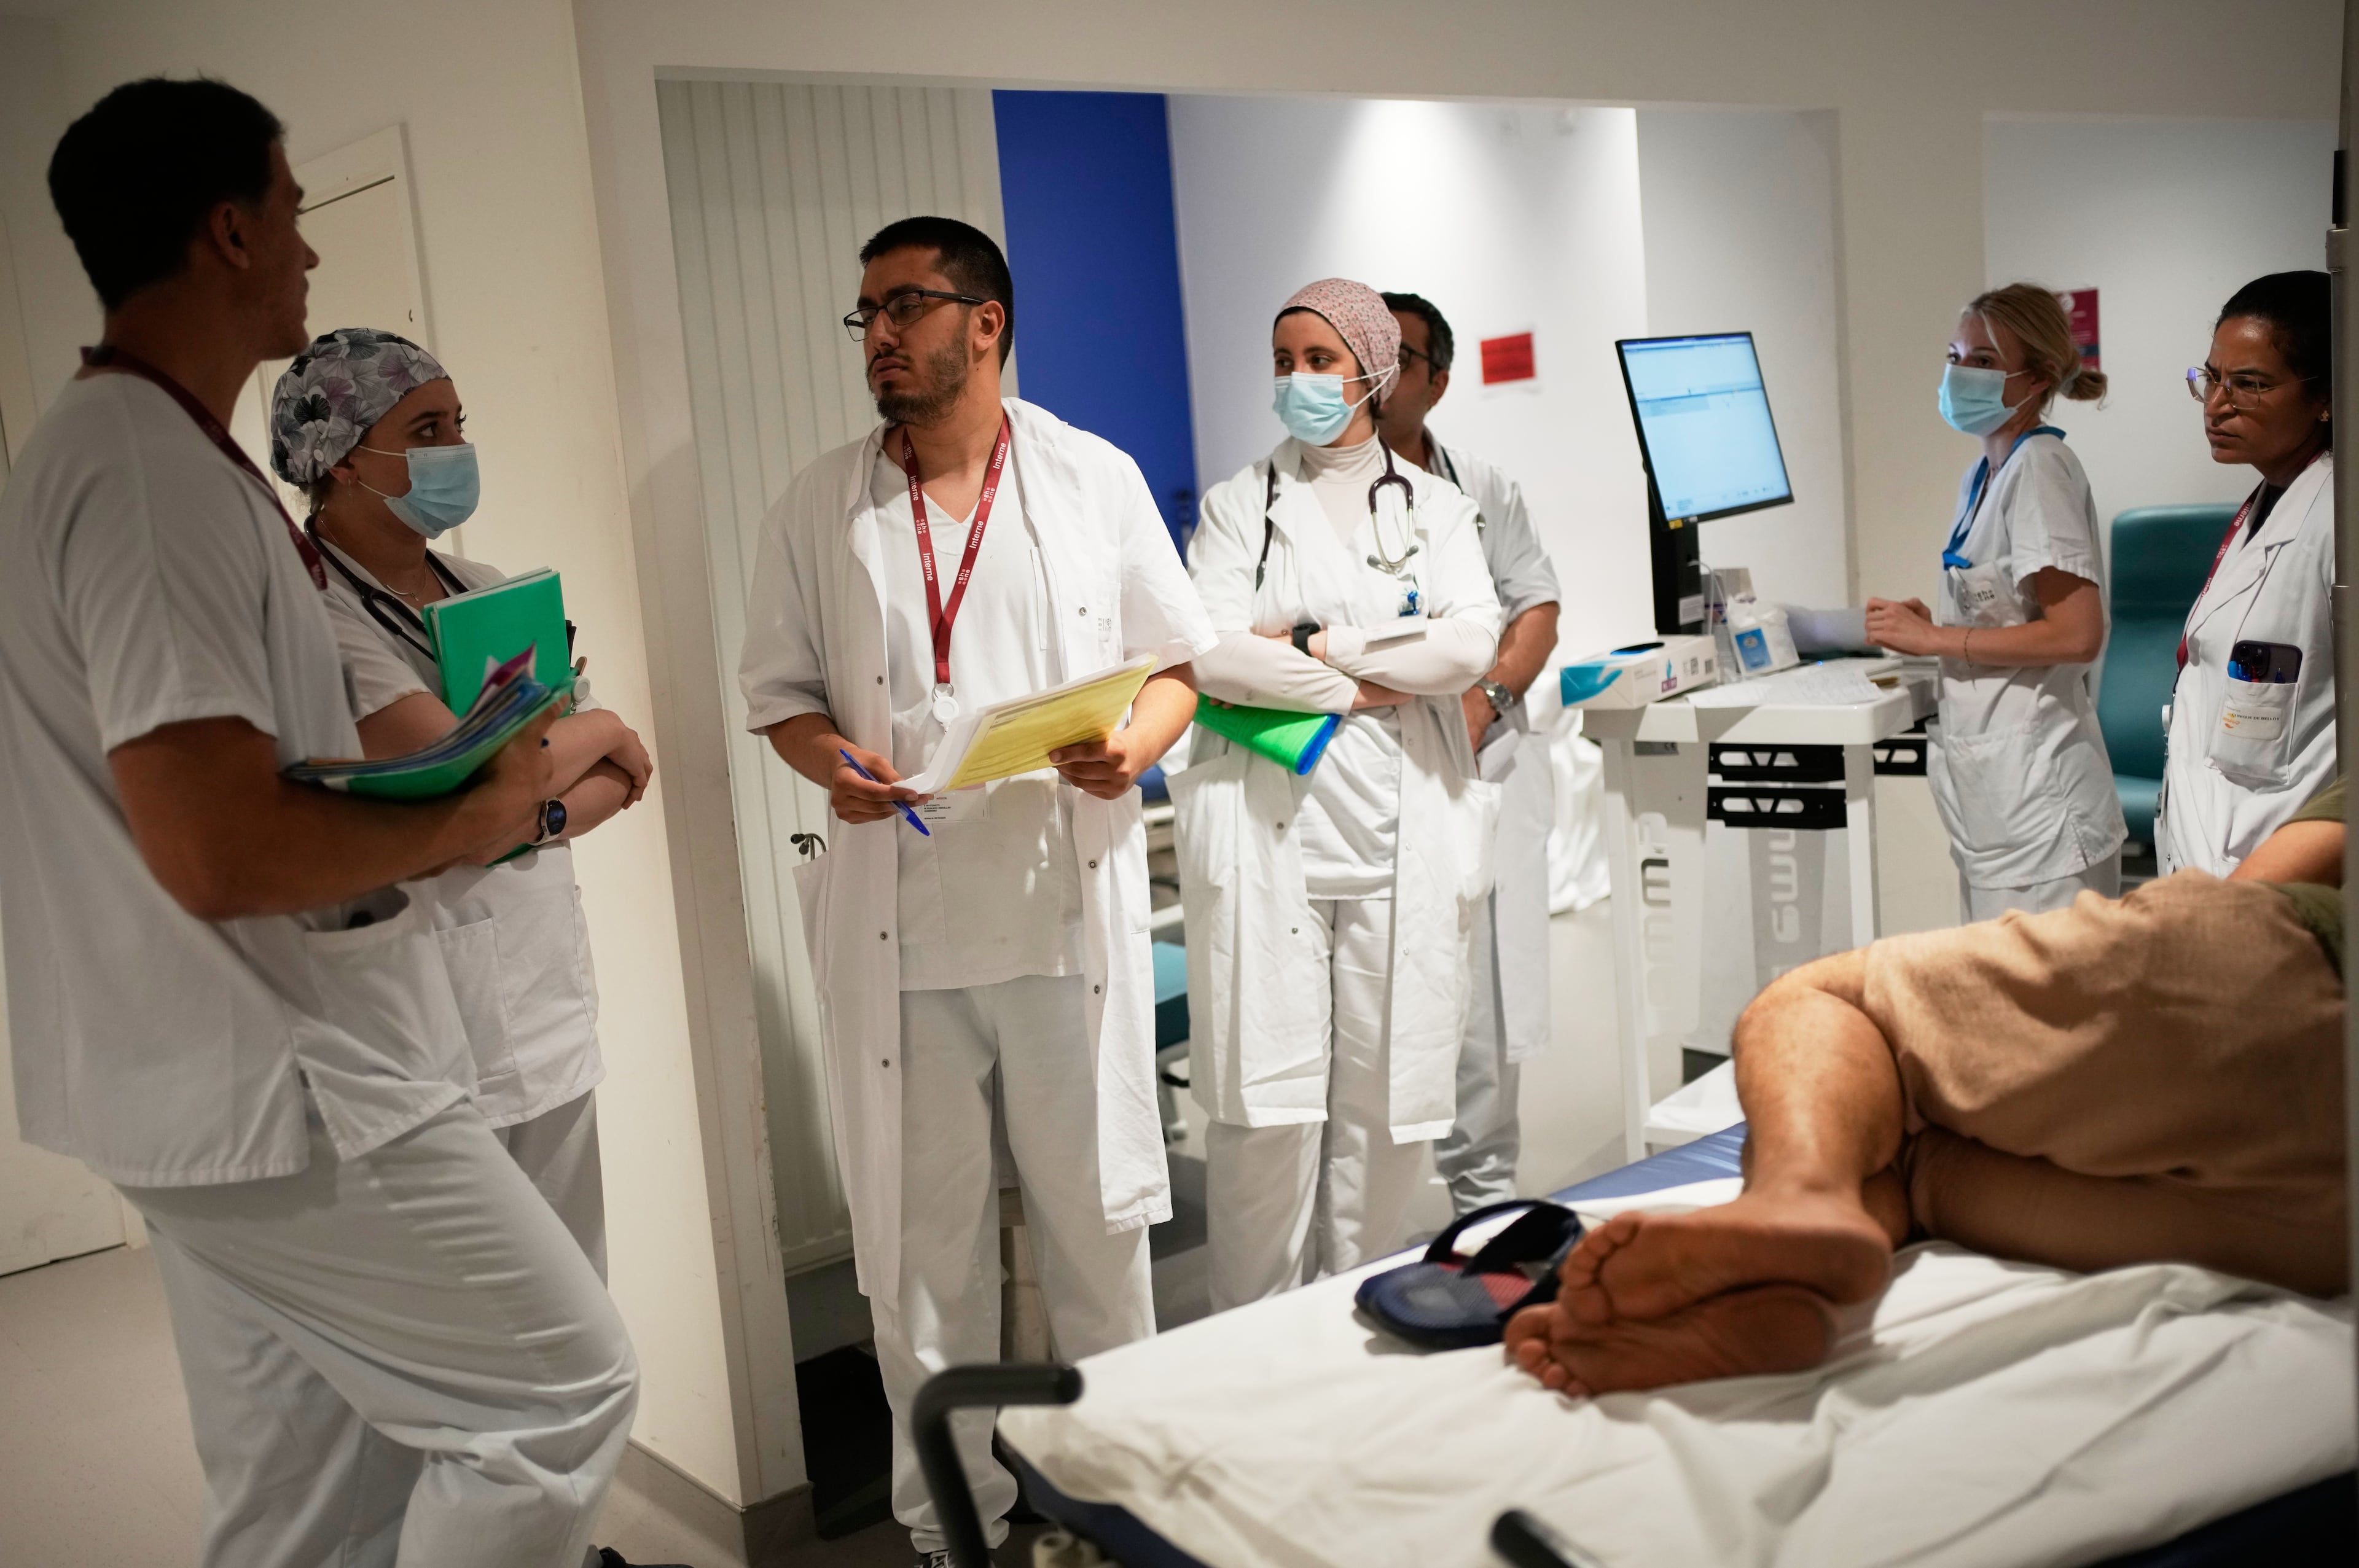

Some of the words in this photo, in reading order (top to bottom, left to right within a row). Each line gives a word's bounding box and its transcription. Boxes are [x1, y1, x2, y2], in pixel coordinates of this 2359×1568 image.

[993, 442, 1006, 469] Interne
[910, 475, 919, 501] Interne
[2234, 502, 2252, 527] Interne
[969, 520, 984, 549] Interne
[923, 553, 933, 581] Interne
